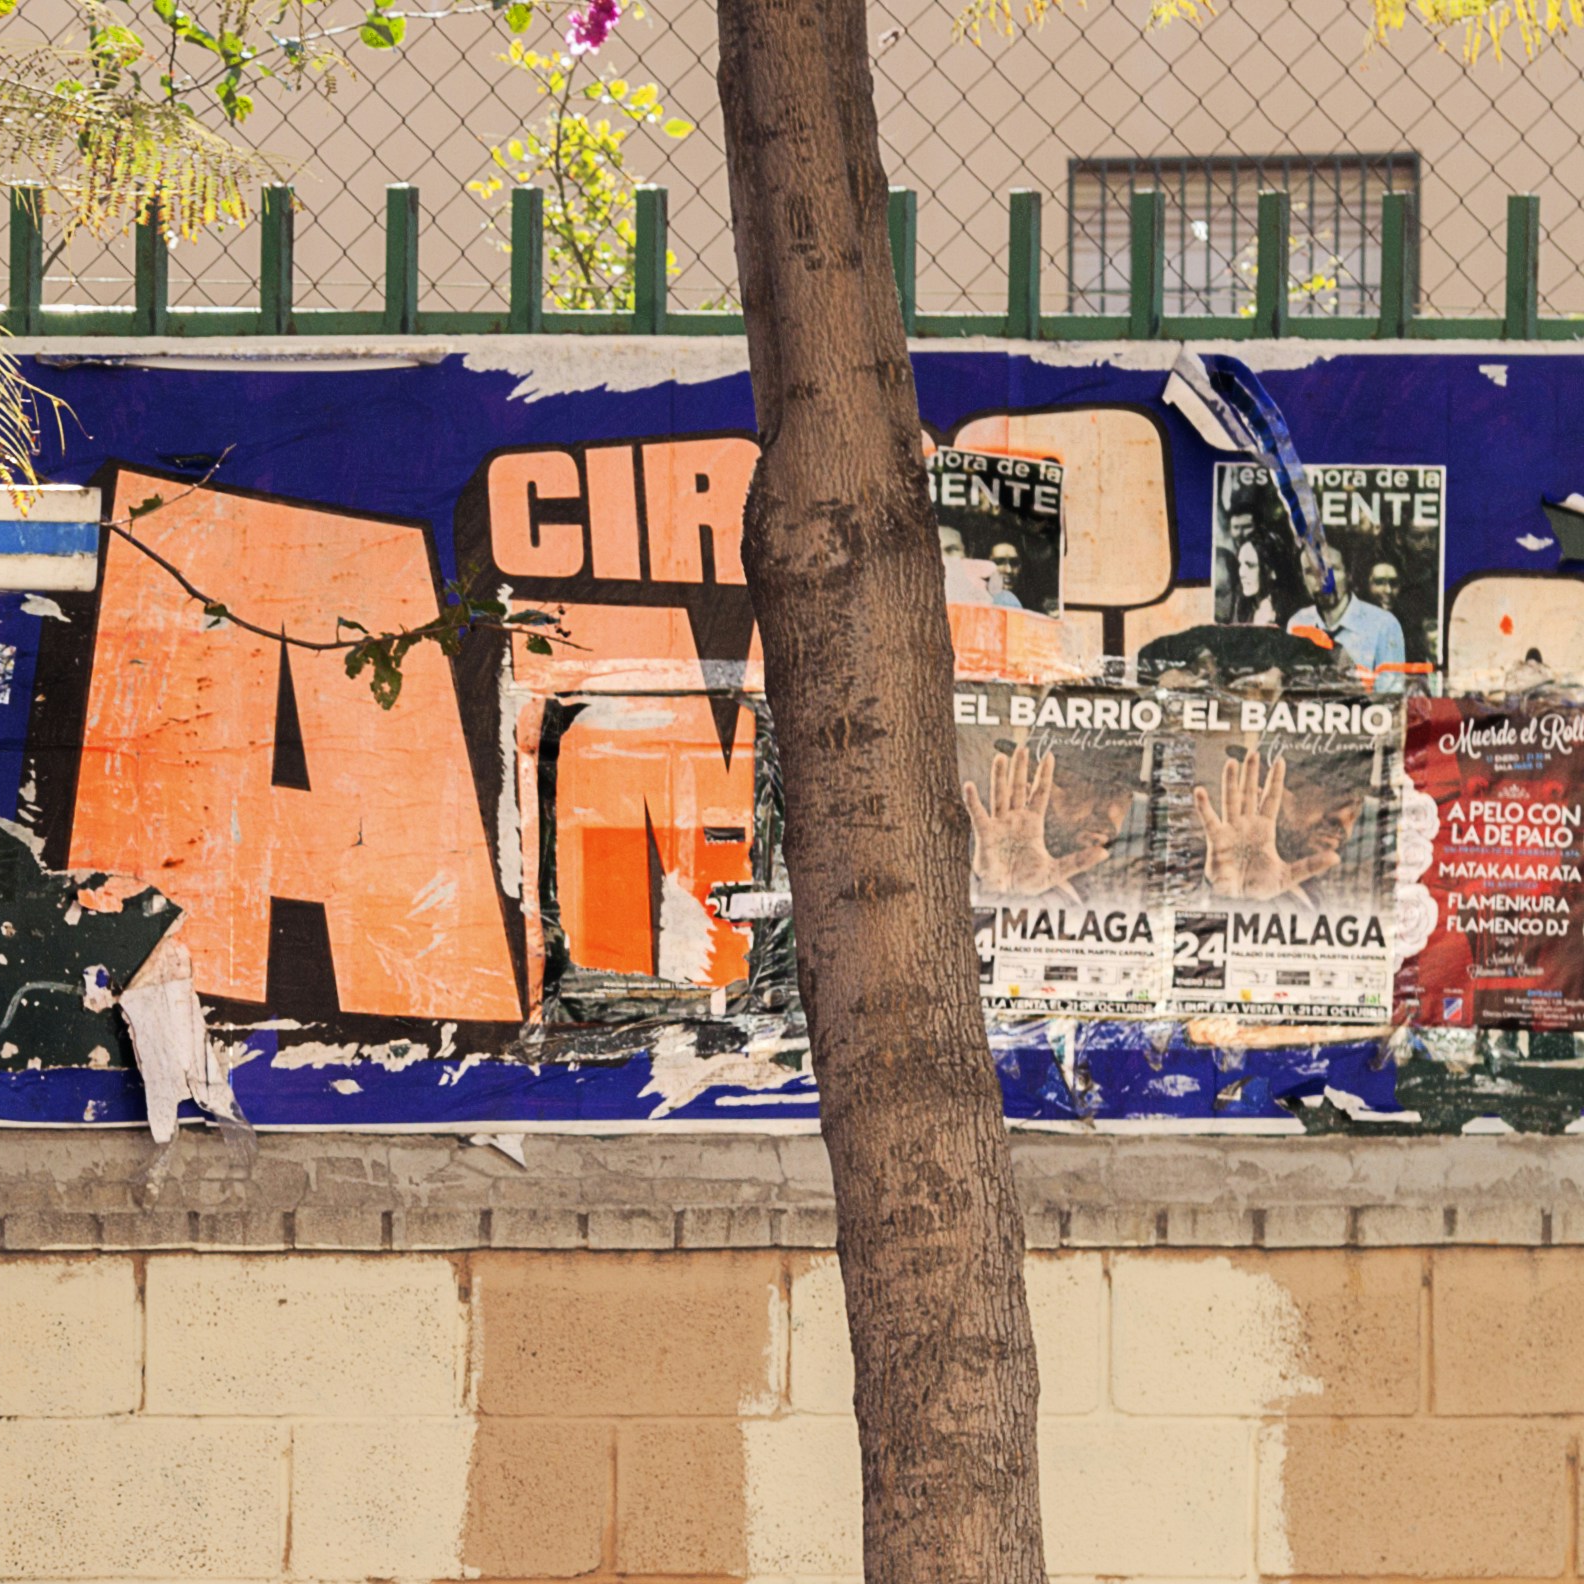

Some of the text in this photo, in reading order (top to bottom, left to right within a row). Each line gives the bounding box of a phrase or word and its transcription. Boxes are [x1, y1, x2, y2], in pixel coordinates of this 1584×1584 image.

[997, 459, 1030, 478] de
[1040, 463, 1062, 484] la
[1309, 470, 1367, 487] hora
[1376, 471, 1409, 487] de
[1419, 471, 1440, 489] la
[1322, 492, 1439, 527] ENTE
[954, 693, 1162, 731] EL BARRIO
[1182, 700, 1392, 735] EL BARRIO
[1439, 714, 1584, 759] Muerde el Roll
[1447, 801, 1581, 826] A PELO CON
[1451, 823, 1573, 848] LA DE PALO
[1439, 862, 1582, 882] MATAKALARATA
[1448, 892, 1570, 914] FLAMENKURA
[1001, 907, 1153, 943] MALAGA
[1233, 912, 1386, 948] MALAGA
[1446, 915, 1570, 936] FLAMENCO DJ
[1173, 931, 1227, 968] 24
